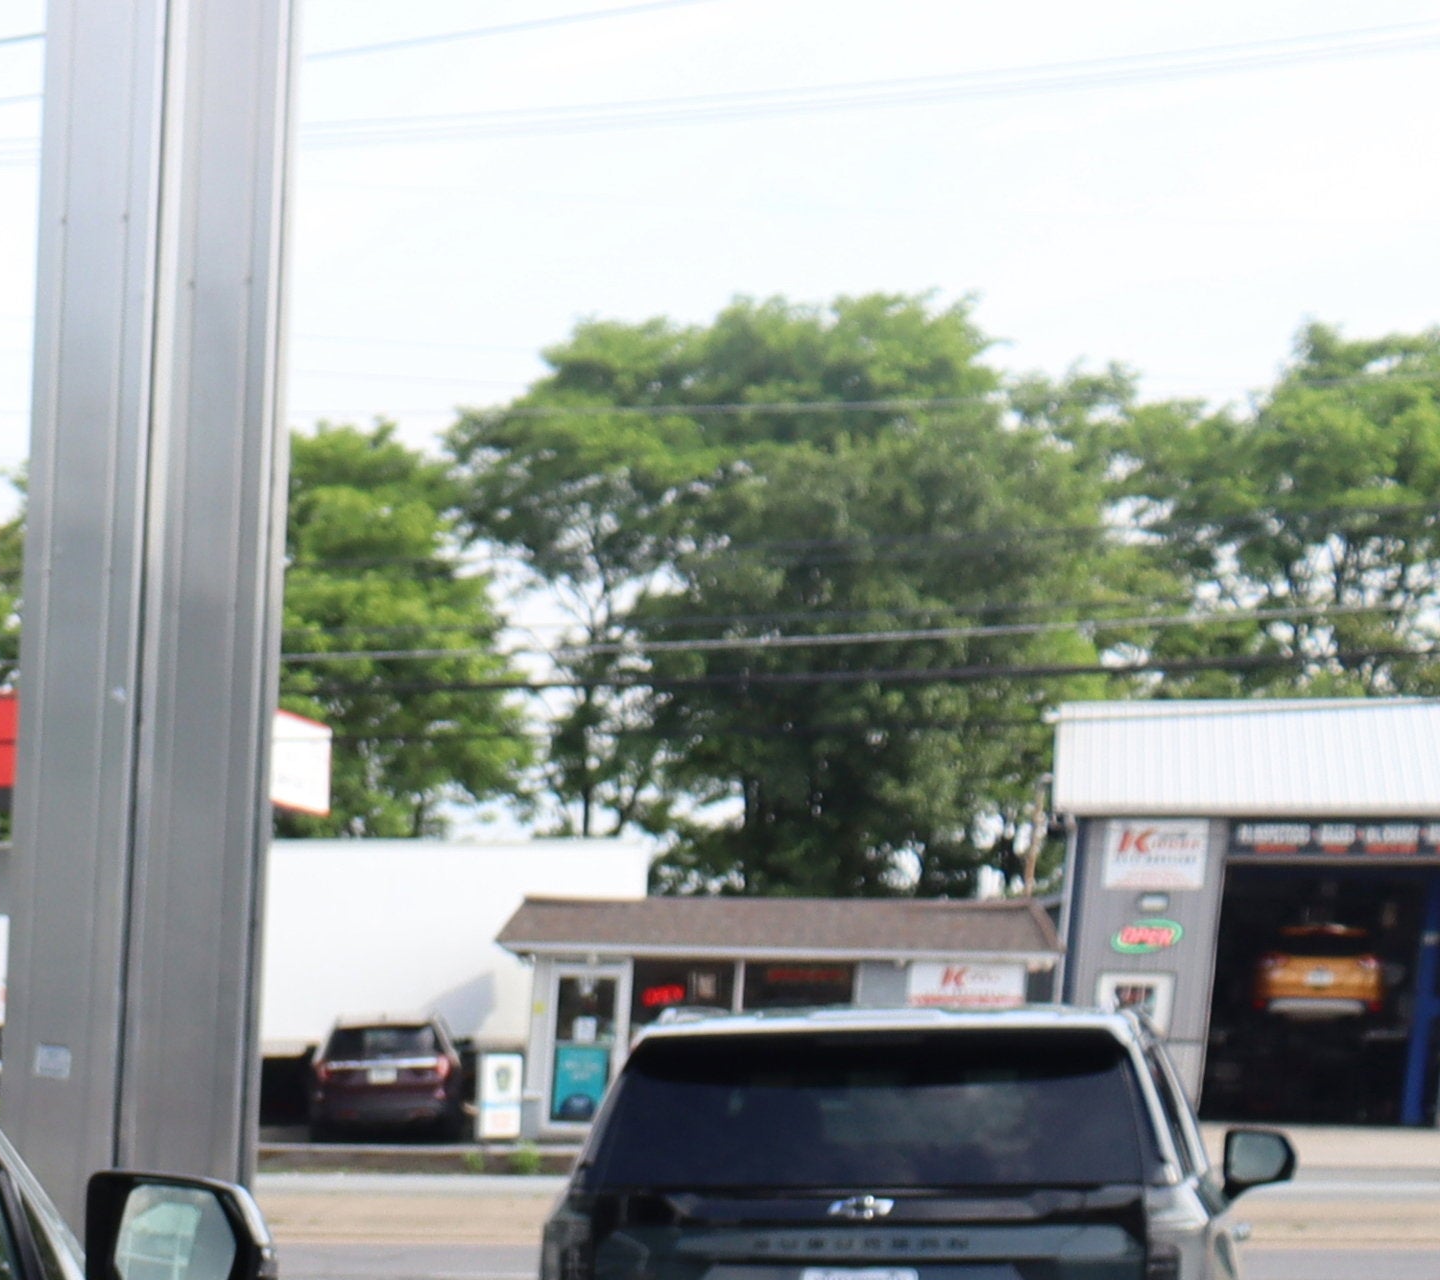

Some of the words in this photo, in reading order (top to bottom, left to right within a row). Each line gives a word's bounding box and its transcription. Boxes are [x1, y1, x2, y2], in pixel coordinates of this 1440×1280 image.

[1120, 926, 1174, 948] OPEN
[642, 984, 685, 1008] OPEN
[753, 1237, 969, 1251] SUBURBAN
